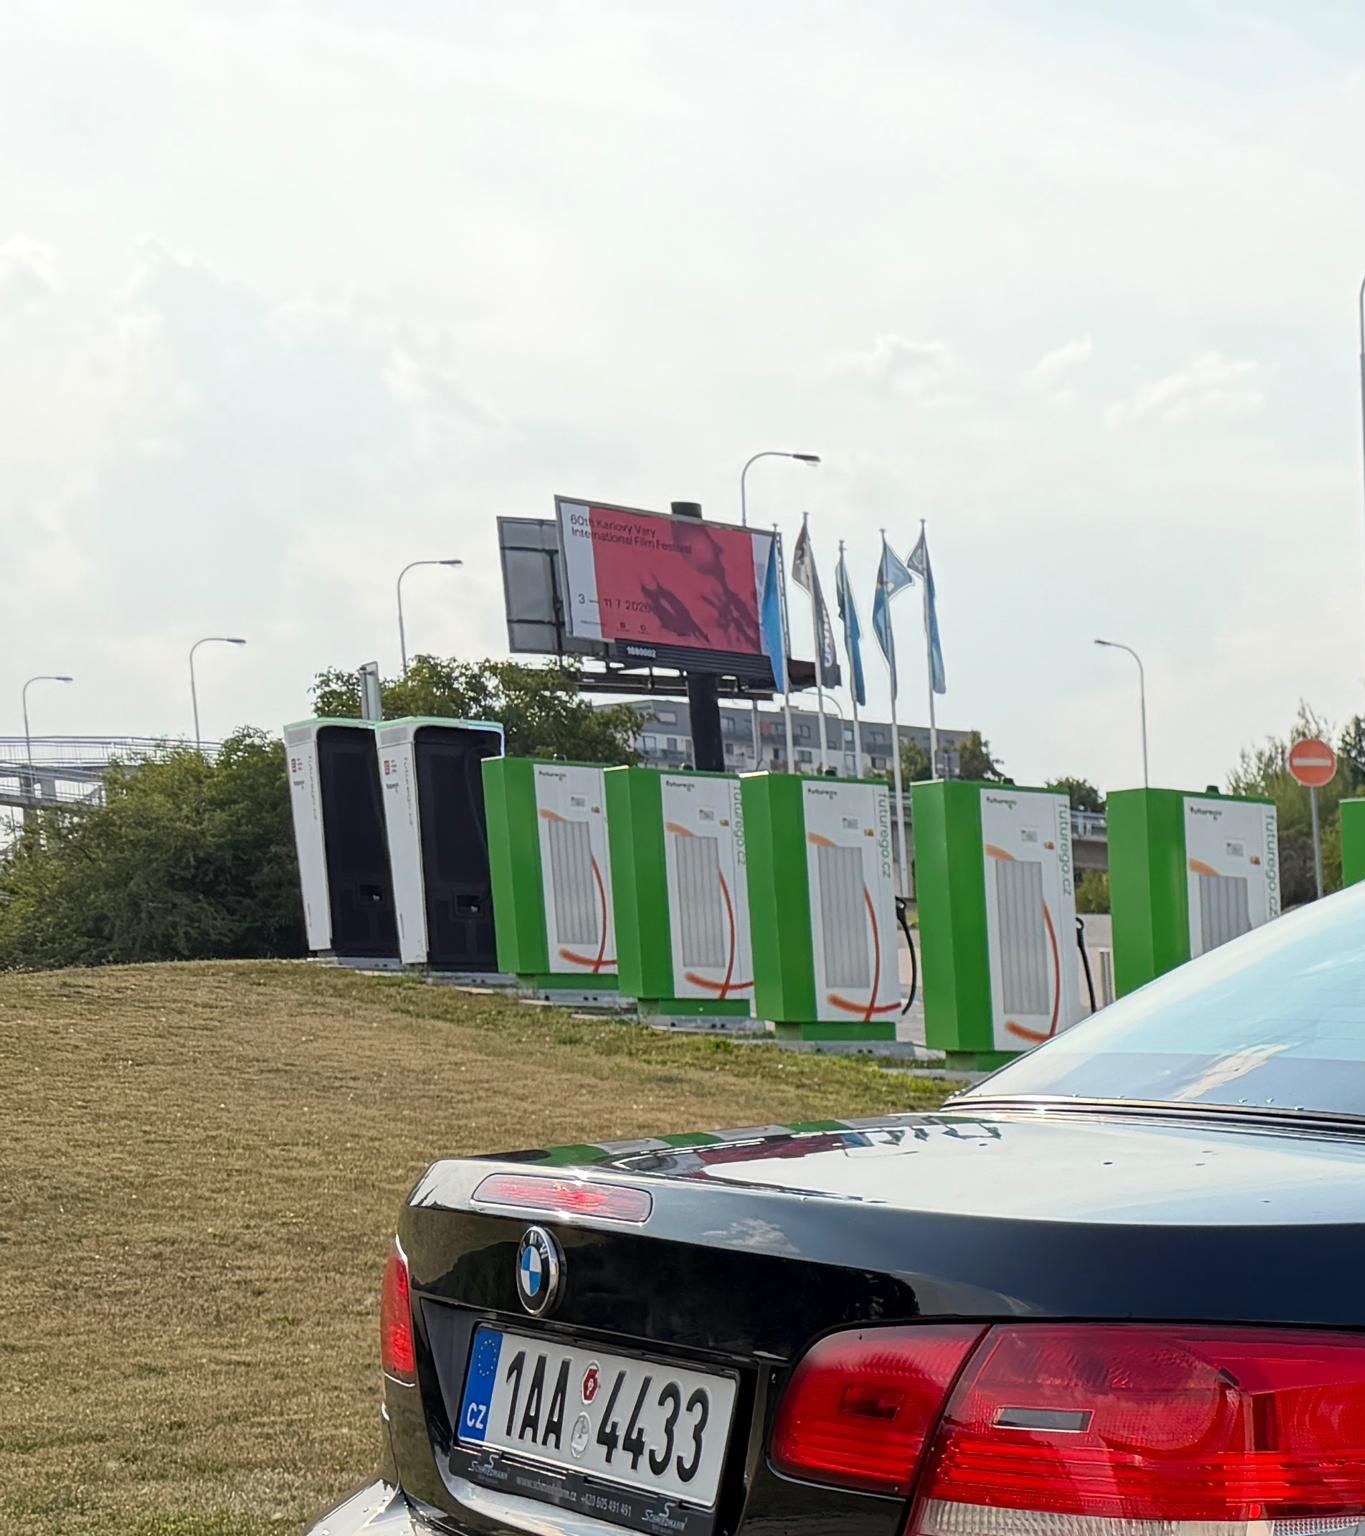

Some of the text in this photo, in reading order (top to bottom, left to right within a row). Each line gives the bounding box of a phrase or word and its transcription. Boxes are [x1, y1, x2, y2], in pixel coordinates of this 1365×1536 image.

[571, 526, 633, 546] International
[634, 535, 655, 549] Film
[596, 518, 633, 535] Karlovy
[633, 524, 656, 538] Vary
[578, 593, 586, 605] 3
[878, 791, 891, 879] futurego.cz
[1058, 803, 1072, 897] futurego.cz
[1264, 814, 1279, 919] futurego.cz
[466, 1402, 487, 1430] CZ
[505, 1350, 710, 1483] 1AA 4433
